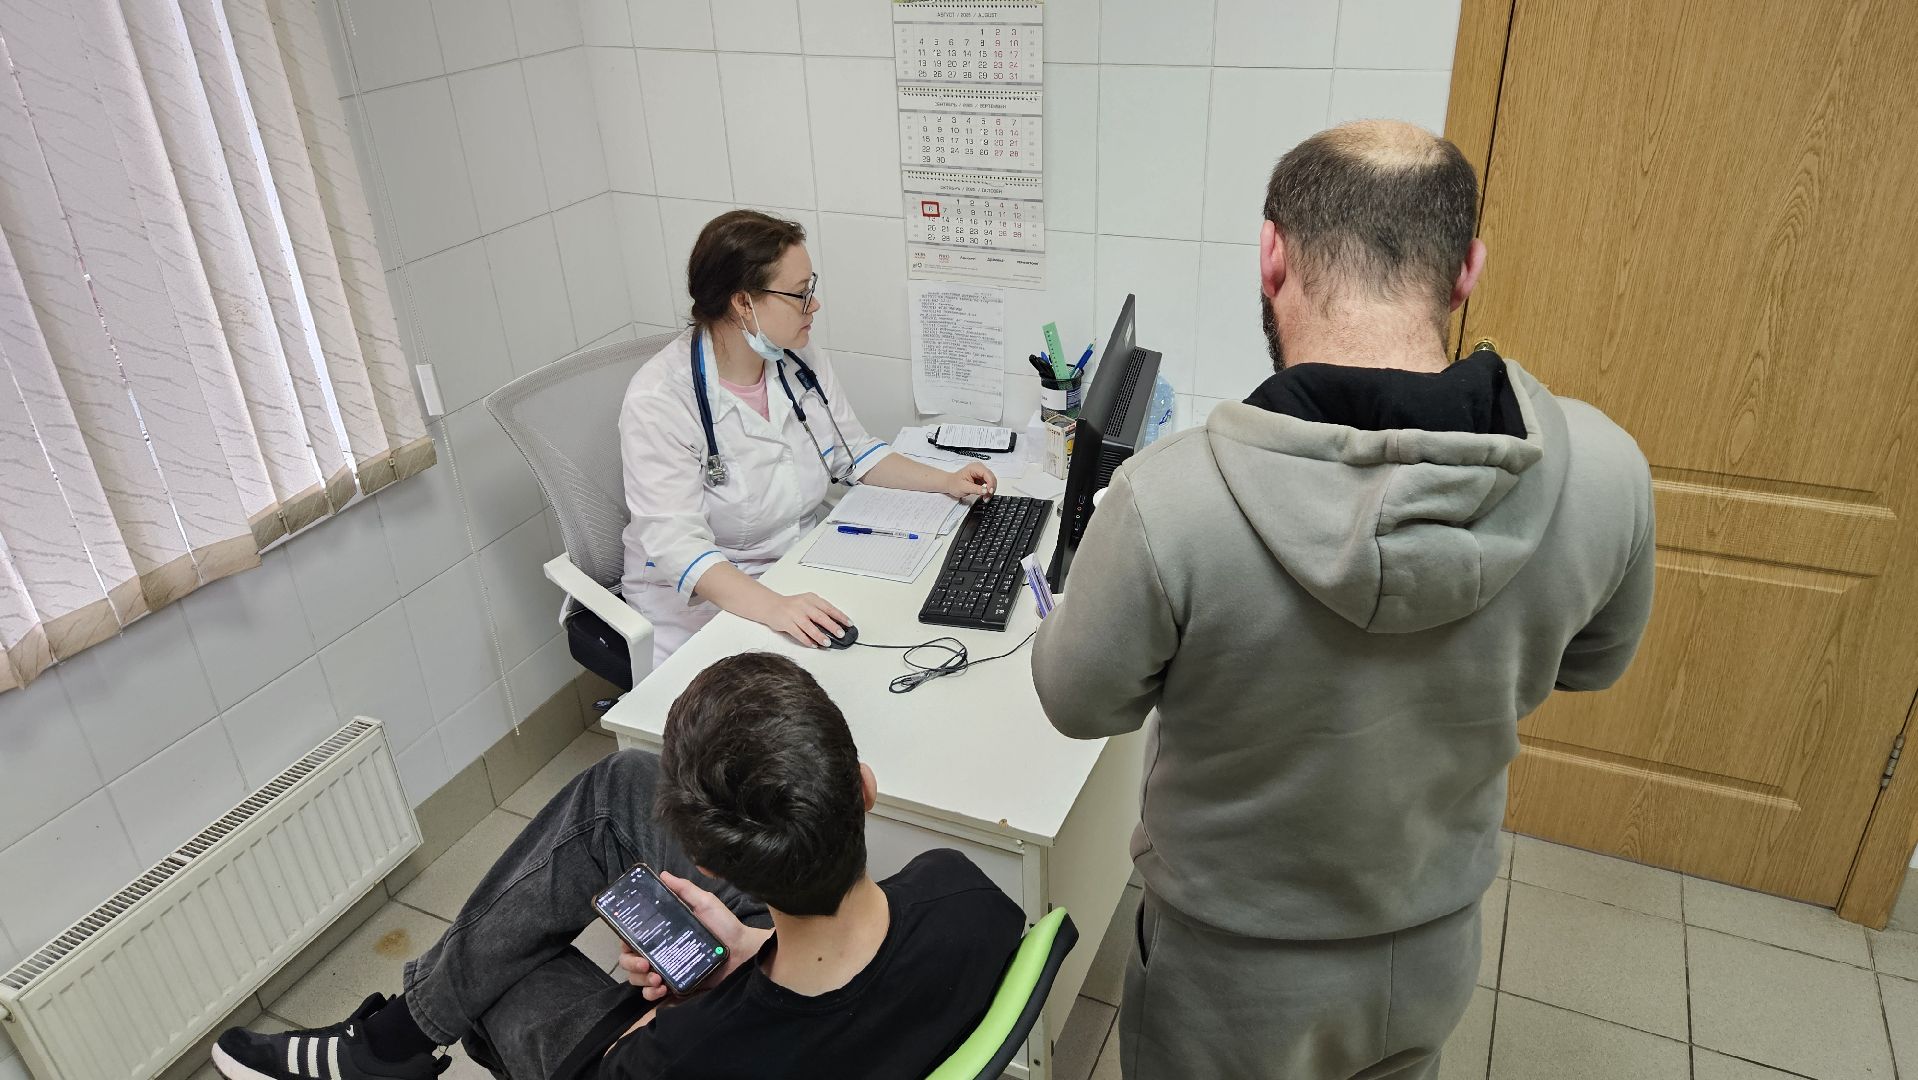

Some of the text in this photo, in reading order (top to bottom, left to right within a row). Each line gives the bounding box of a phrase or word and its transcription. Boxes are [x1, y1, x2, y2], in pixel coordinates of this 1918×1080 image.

[955, 236, 965, 244] 29
[969, 237, 979, 245] 30
[984, 238, 993, 246] 31
